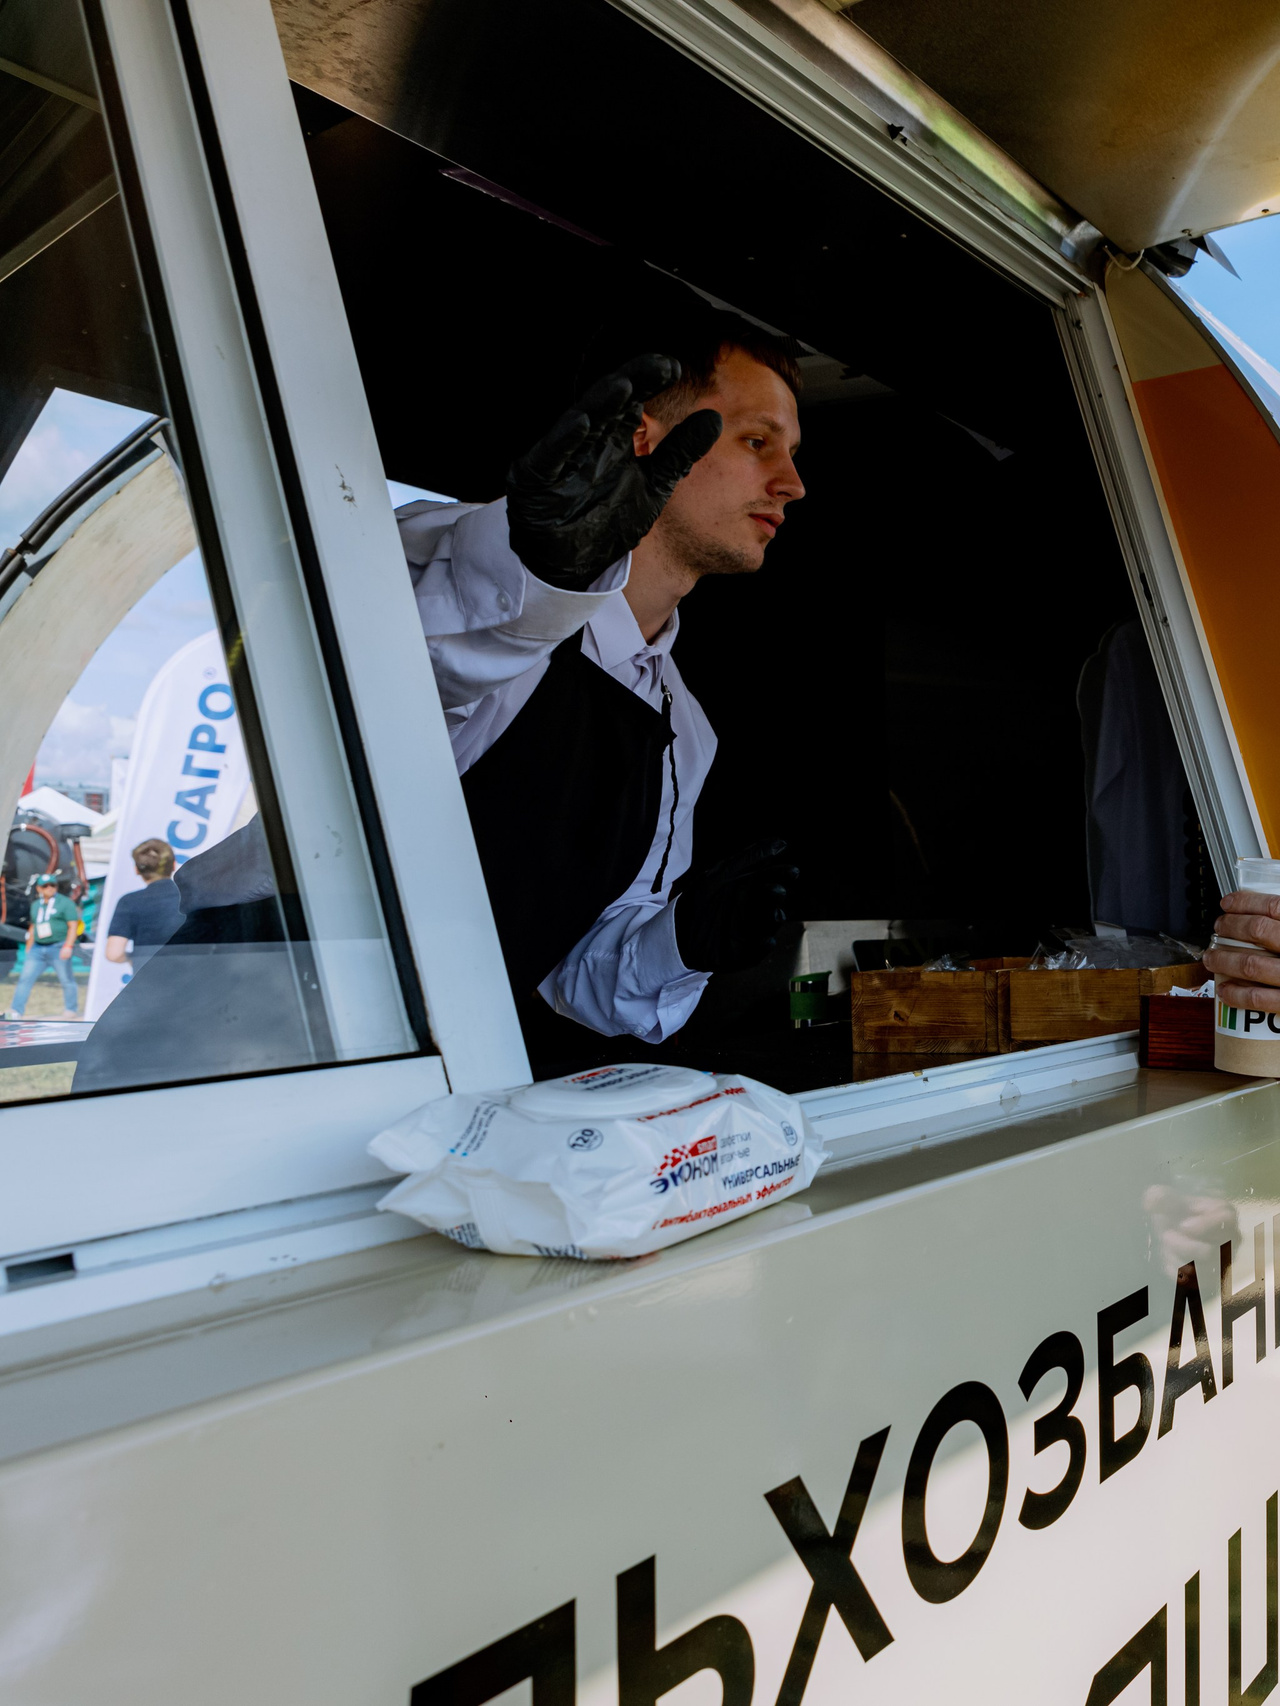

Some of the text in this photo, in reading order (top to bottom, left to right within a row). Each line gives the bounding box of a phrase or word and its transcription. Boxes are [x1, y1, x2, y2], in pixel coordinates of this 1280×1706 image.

[167, 682, 236, 864] САГРО
[570, 1129, 595, 1149] 120
[650, 1152, 719, 1195] ЭКОНОМ
[720, 1154, 801, 1191] УНИВЕРСАЛЬНЫЕ
